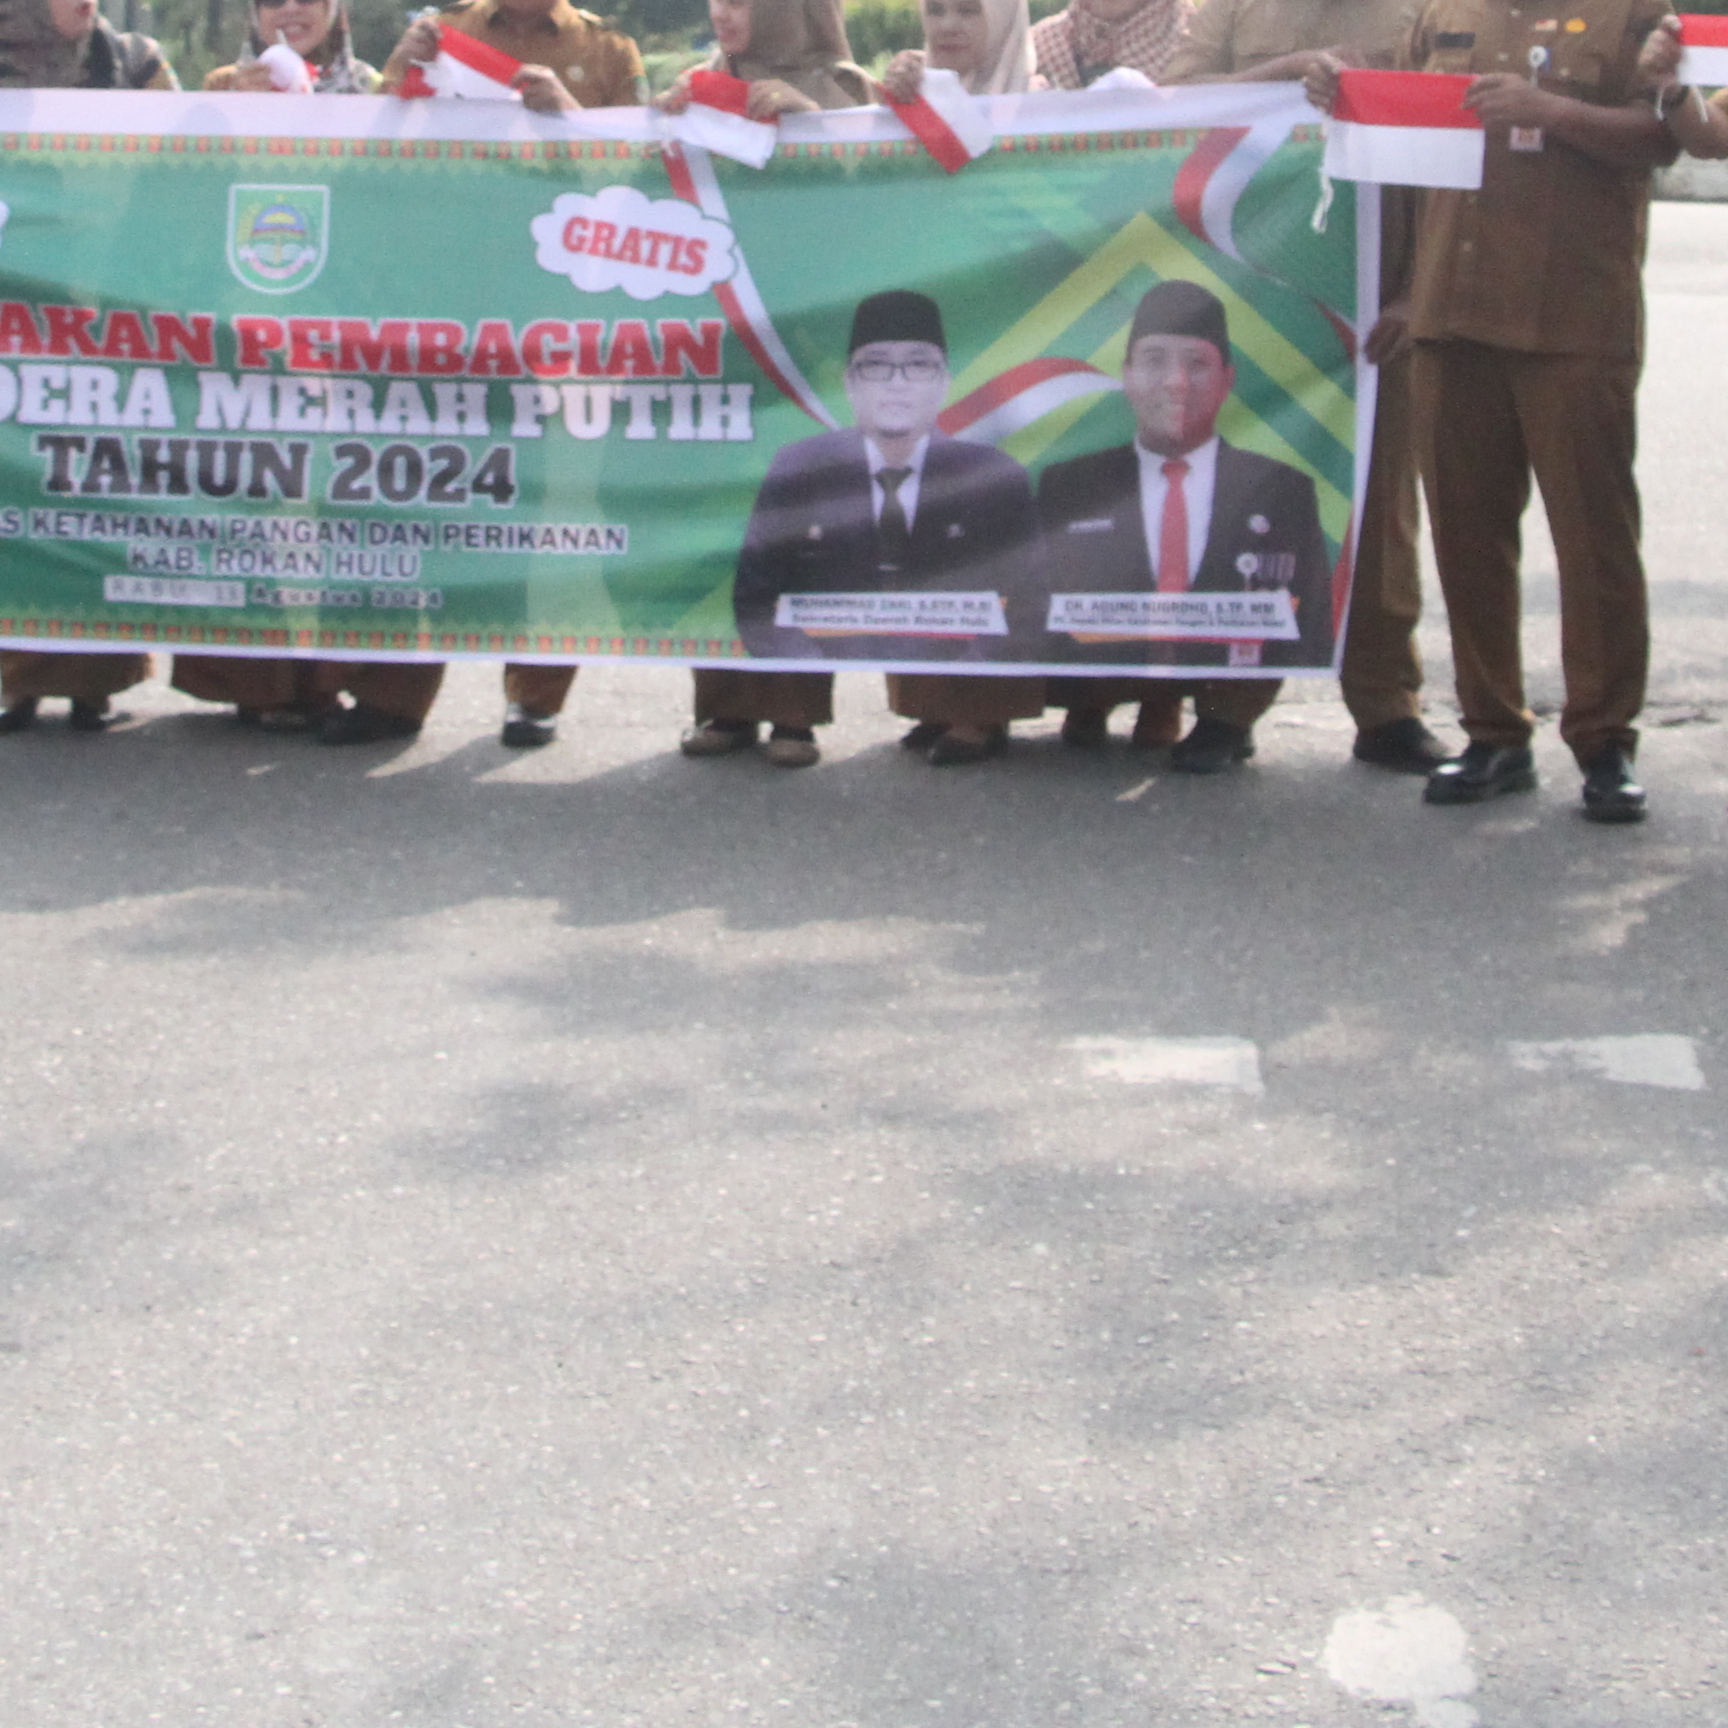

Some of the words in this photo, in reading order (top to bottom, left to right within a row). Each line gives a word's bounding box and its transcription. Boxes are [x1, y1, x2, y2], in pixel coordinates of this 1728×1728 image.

[561, 215, 709, 278] GRATIS
[235, 317, 724, 378] PEMBAGIAN
[195, 371, 490, 438] MERAH
[510, 383, 755, 442] PUTIH
[35, 433, 309, 503] TAHUN
[329, 440, 518, 506] 2024
[30, 511, 219, 542] KETAHANAN
[229, 518, 358, 546] PANGAN
[368, 520, 432, 547] DAN
[442, 523, 628, 552] PERIKANAN
[129, 545, 206, 572] KAB.
[215, 548, 323, 574] ROKAN
[333, 550, 419, 577] HULU
